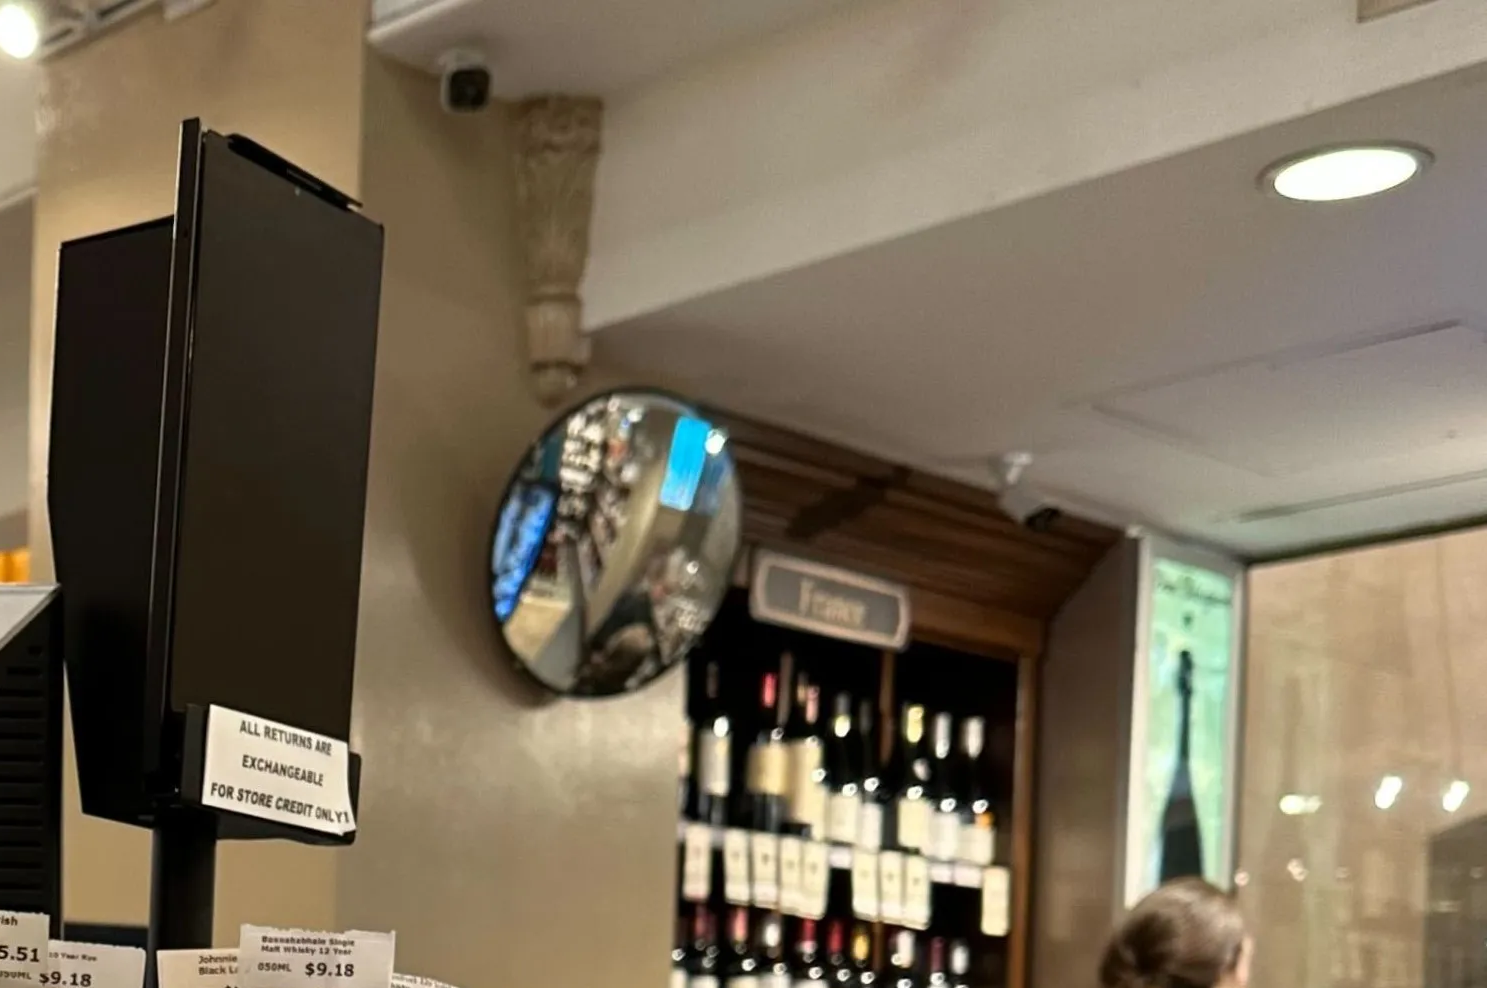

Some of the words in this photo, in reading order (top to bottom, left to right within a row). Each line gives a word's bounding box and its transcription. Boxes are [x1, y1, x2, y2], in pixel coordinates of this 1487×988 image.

[239, 720, 261, 737] ALL
[264, 725, 313, 750] RETURNS
[315, 738, 333, 756] ARE
[242, 754, 324, 786] EXCHANGEABLE
[211, 782, 234, 800] FOR
[237, 788, 274, 809] STORE
[275, 797, 314, 818] CREDIT
[198, 955, 238, 965] Johnnie
[39, 970, 92, 988] $9.18
[198, 966, 227, 976] Black
[257, 962, 292, 973] 050ML
[305, 962, 355, 978] $9.18
